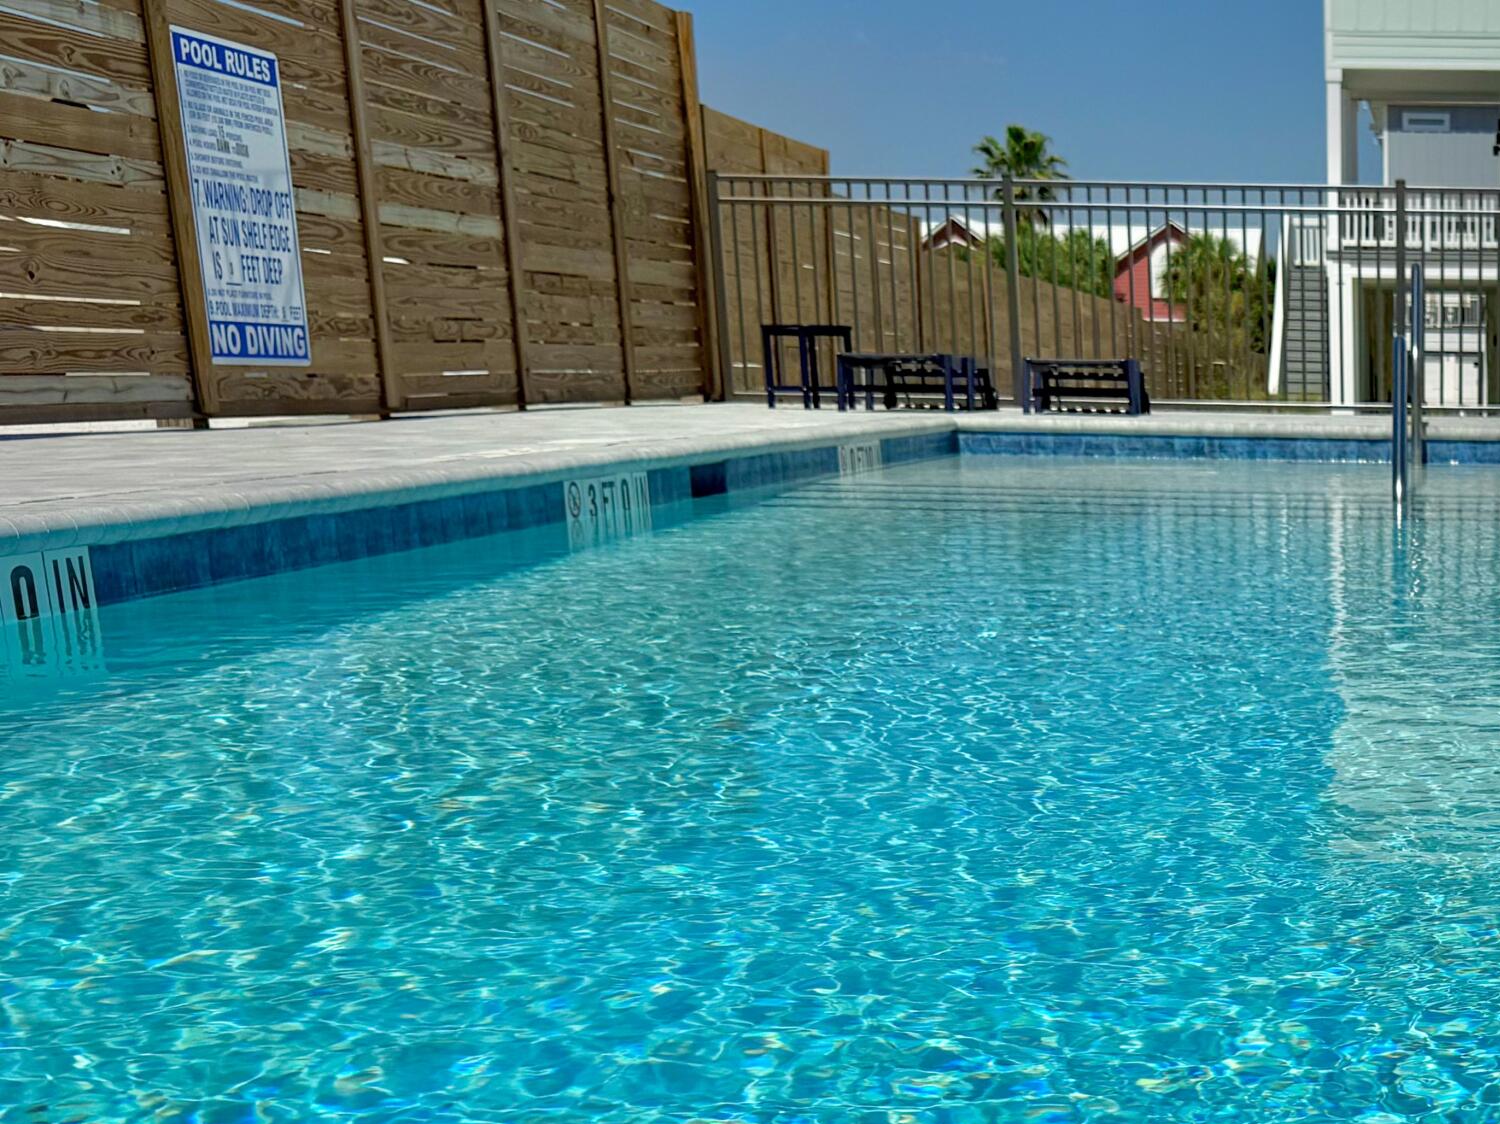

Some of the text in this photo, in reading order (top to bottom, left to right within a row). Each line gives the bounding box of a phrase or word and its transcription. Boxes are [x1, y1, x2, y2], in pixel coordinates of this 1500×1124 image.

[180, 37, 270, 82] POOL RULES
[250, 187, 272, 217] DROP
[275, 191, 289, 219] OFF
[209, 216, 291, 252] AT SUN SHELF EDGE
[212, 250, 223, 280] IS
[240, 254, 260, 283] FEET
[262, 257, 283, 285] DEEP
[211, 324, 306, 357] NO DIVING
[588, 484, 598, 517] 3
[601, 481, 615, 515] FT
[621, 479, 631, 511] 0
[10, 555, 91, 620] 0 IN
